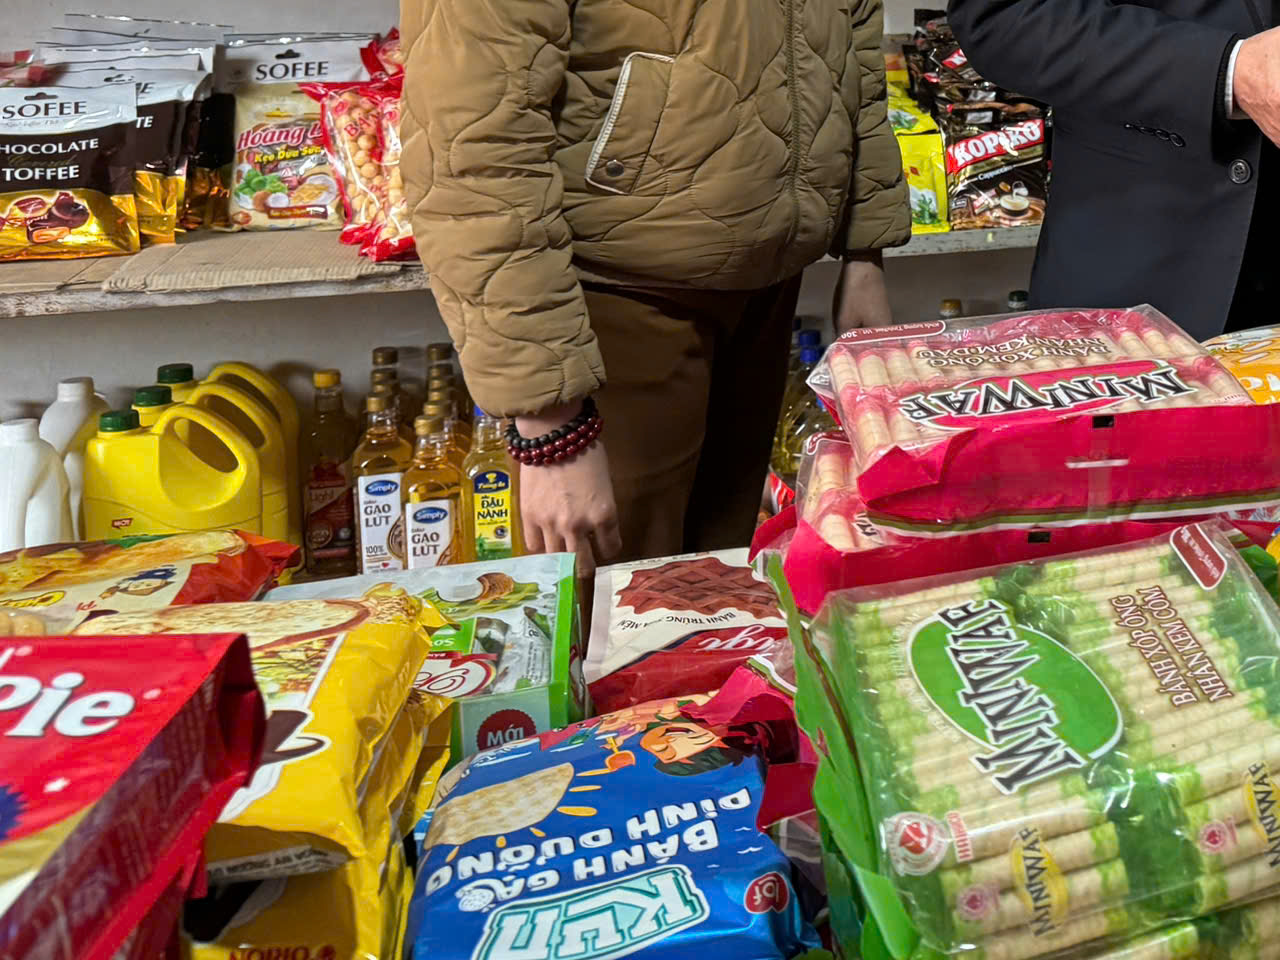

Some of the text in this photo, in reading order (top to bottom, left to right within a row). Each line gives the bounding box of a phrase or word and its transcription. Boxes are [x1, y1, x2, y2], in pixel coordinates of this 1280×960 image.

[256, 61, 329, 81] SOFEE
[2, 101, 87, 119] SOFEE
[0, 138, 99, 154] HOCOLATE
[954, 121, 1042, 168] KOPIKO
[2, 165, 80, 181] TOFFEE
[367, 483, 397, 495] Simply
[415, 510, 447, 521] Simply
[1159, 618, 1203, 653] KEM
[1150, 657, 1199, 708] BÁNH
[0, 671, 135, 738] Pie
[425, 827, 612, 897] DƯỠNG
[573, 819, 721, 880] BÁNH
